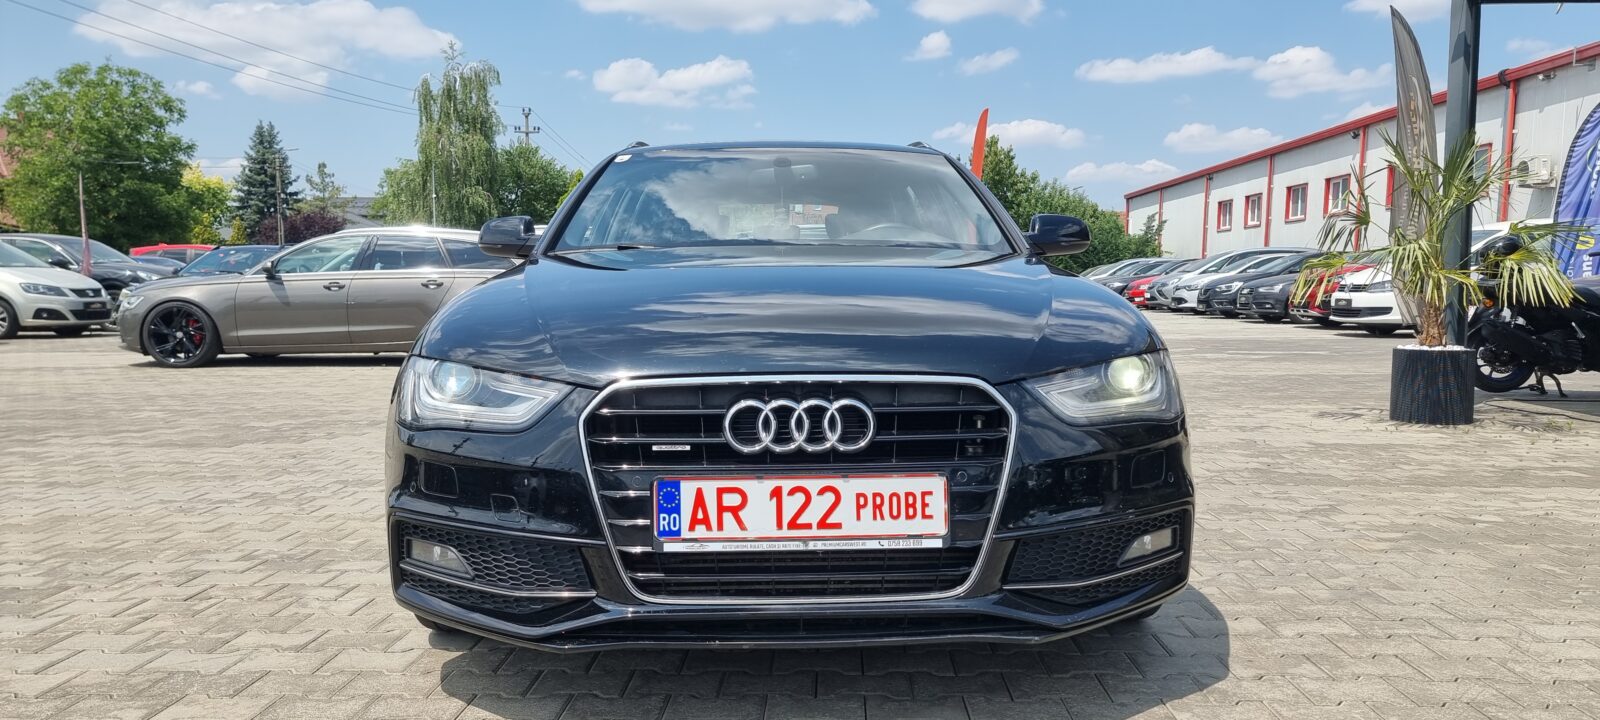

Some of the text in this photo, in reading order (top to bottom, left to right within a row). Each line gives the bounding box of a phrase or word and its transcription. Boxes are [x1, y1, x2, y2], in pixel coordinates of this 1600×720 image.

[659, 513, 680, 531] RO
[688, 485, 934, 532] AR 122 PROBE
